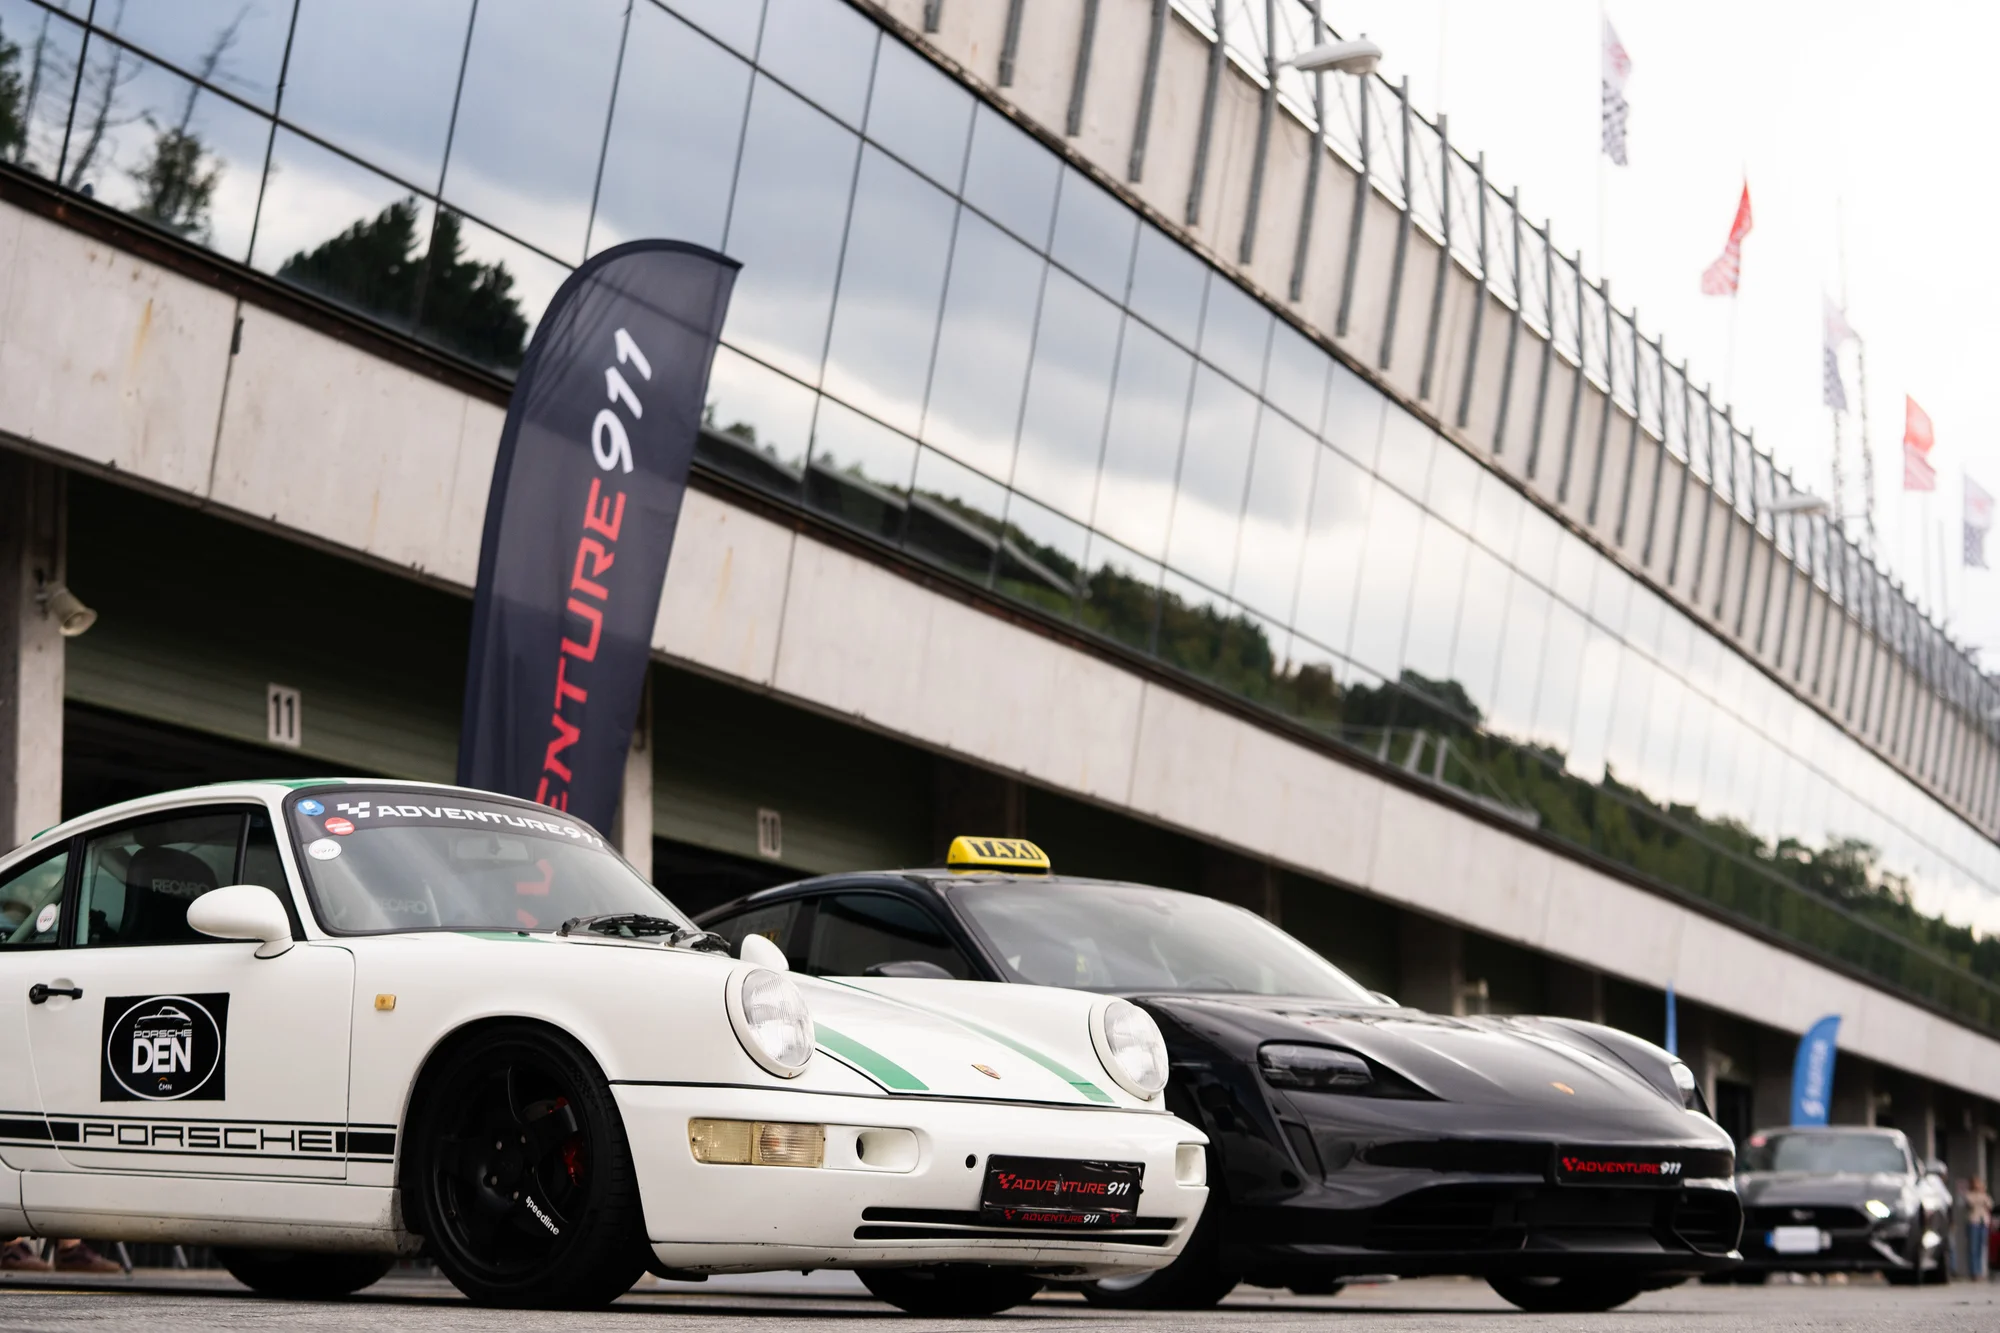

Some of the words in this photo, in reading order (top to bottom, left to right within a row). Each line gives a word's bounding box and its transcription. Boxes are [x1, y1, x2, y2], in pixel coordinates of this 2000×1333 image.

[272, 692, 294, 739] 11
[376, 805, 604, 848] ADVENTURE911
[968, 839, 1042, 861] TAXI
[133, 1028, 192, 1038] PORSCHE
[132, 1037, 193, 1074] DEN
[83, 1122, 333, 1152] PORSCHE
[1575, 1161, 1681, 1174] ADVENTURE911
[1012, 1178, 1130, 1195] ADVENTURE911
[525, 1195, 560, 1235] speedline
[1022, 1212, 1100, 1223] ADVENTURE911
